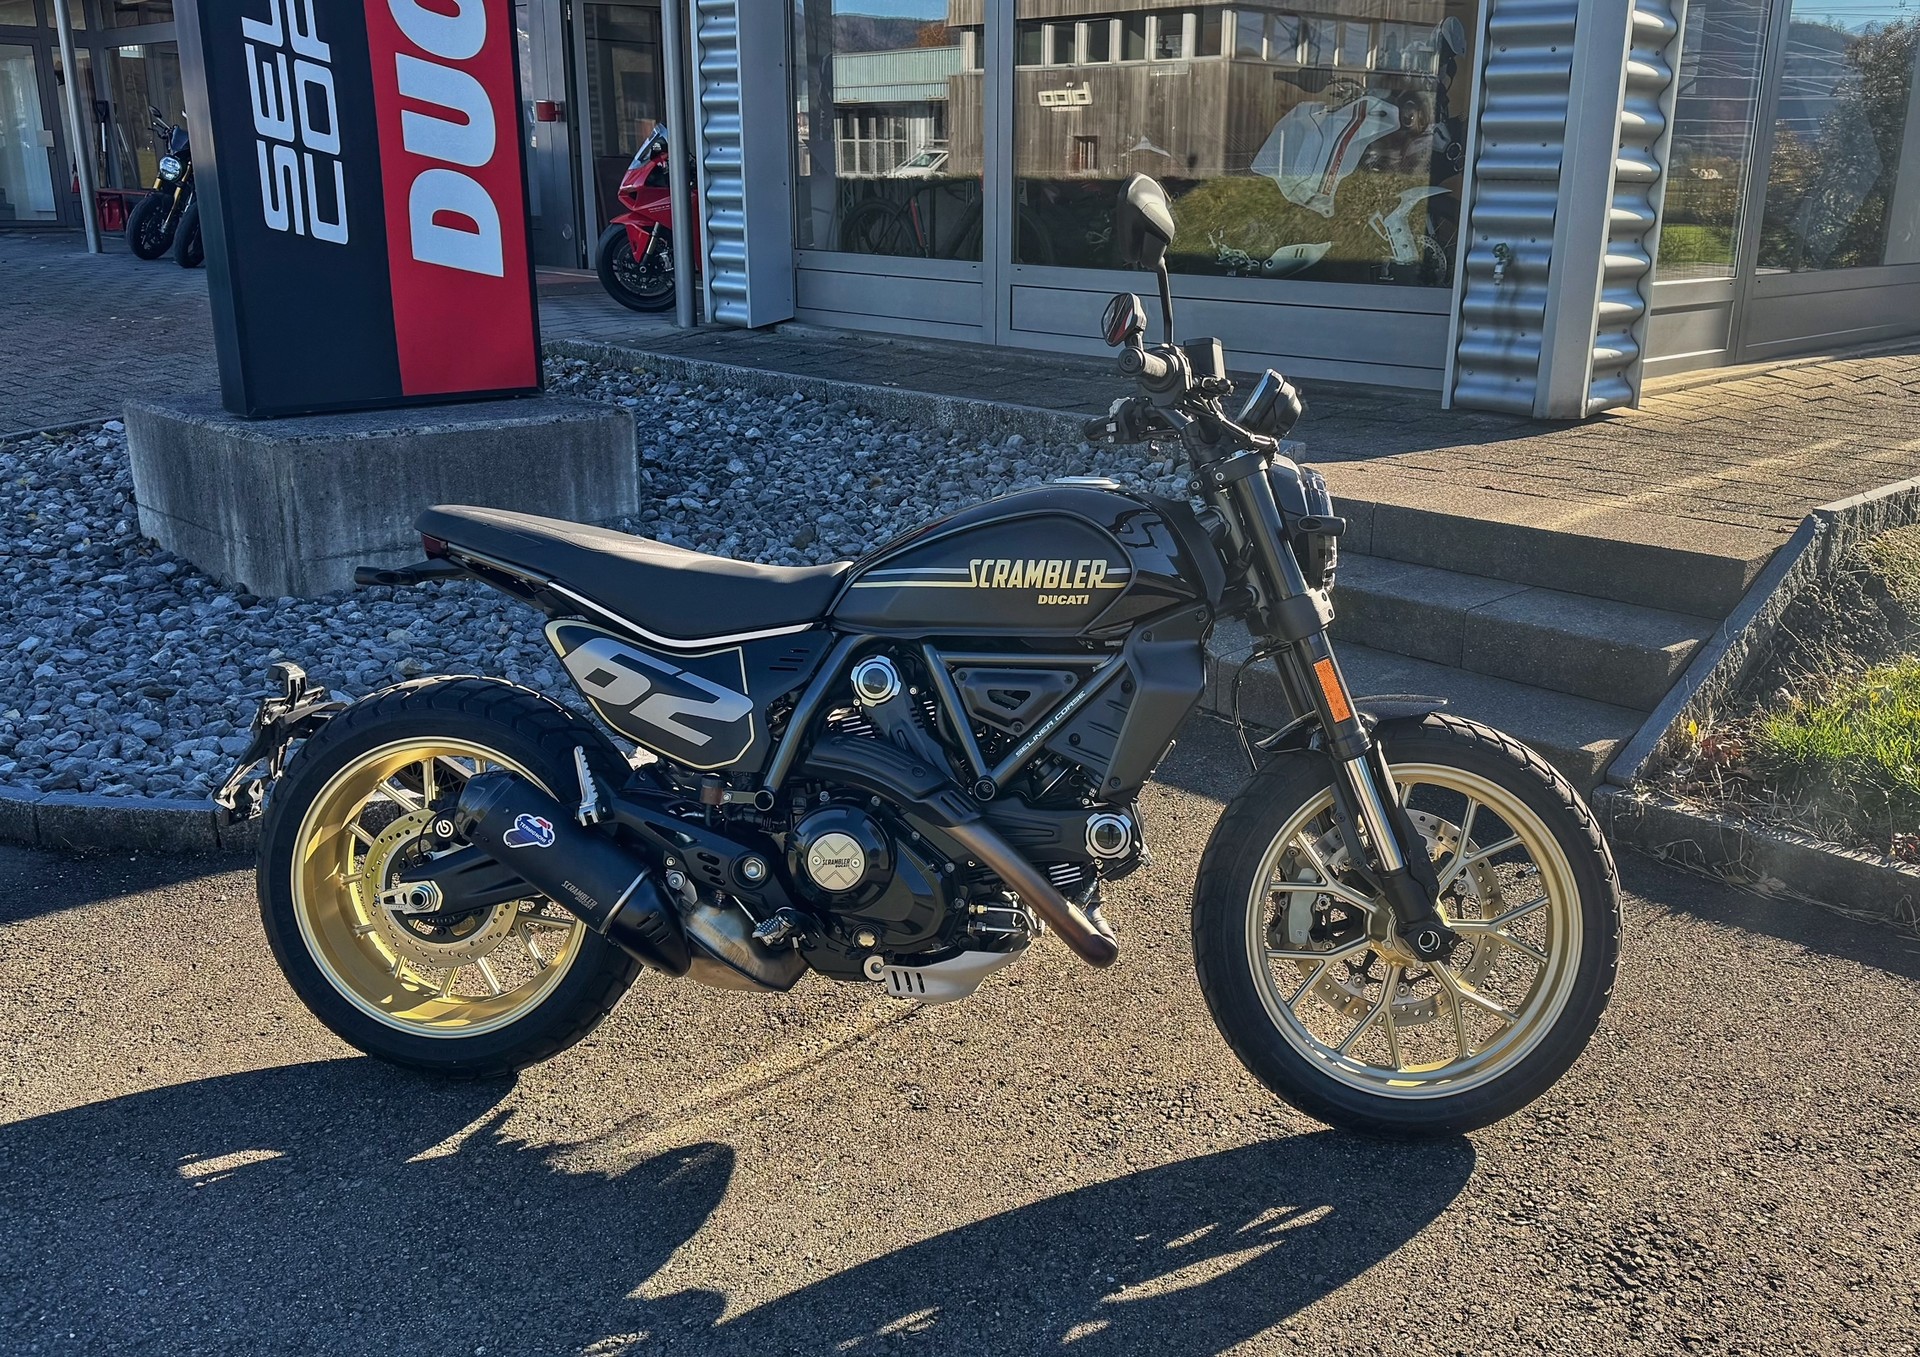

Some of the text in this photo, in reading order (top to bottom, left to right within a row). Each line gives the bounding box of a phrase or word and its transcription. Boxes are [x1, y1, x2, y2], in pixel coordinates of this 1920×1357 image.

[969, 559, 1107, 589] SCRAMBLER
[1037, 594, 1089, 605] DUCATI
[562, 637, 754, 747] 62
[1015, 690, 1086, 757] SELINER CORSE
[518, 821, 547, 843] TERMIGNONI
[822, 858, 850, 866] SCRAMBLER
[561, 880, 598, 909] SCRAMBLER
